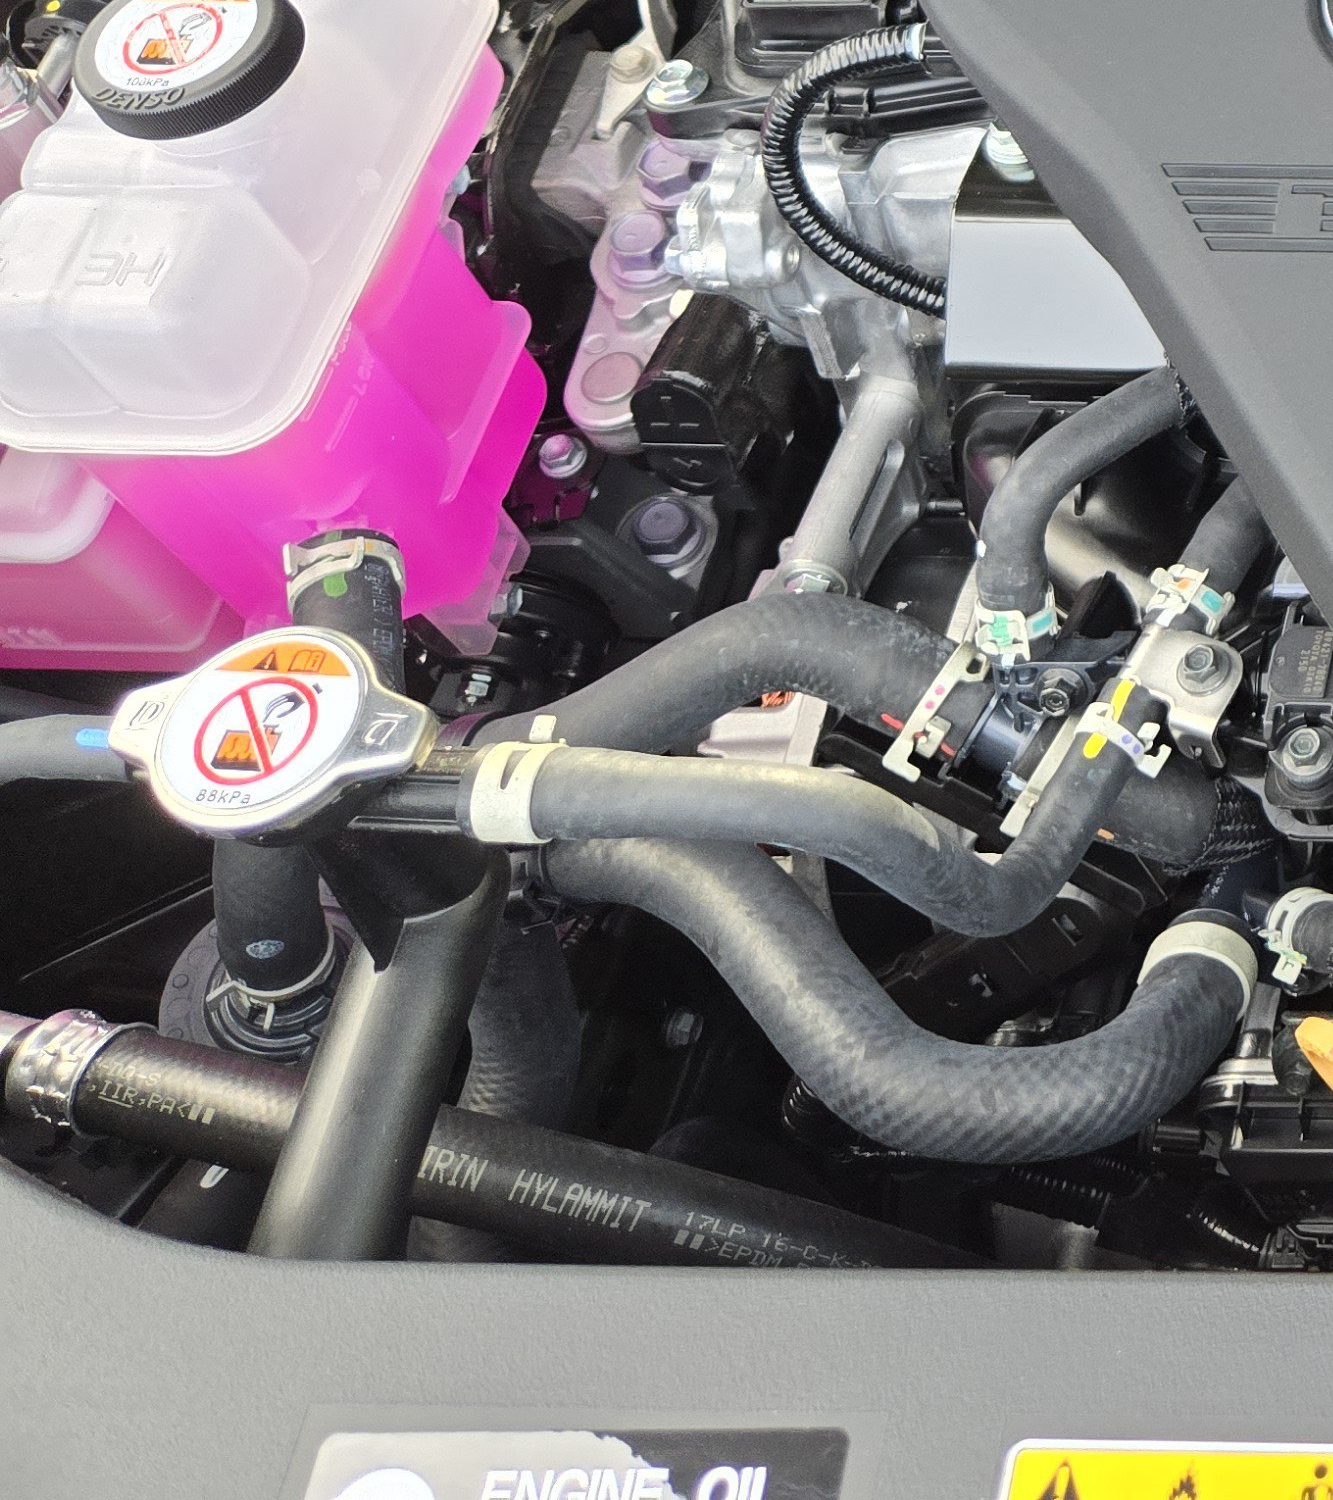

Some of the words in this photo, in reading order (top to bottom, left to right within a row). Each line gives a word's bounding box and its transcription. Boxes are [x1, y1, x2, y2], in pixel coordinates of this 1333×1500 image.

[94, 85, 185, 110] DENSO
[196, 789, 251, 804] 88kPa
[508, 1169, 653, 1235] HYLAMMIT
